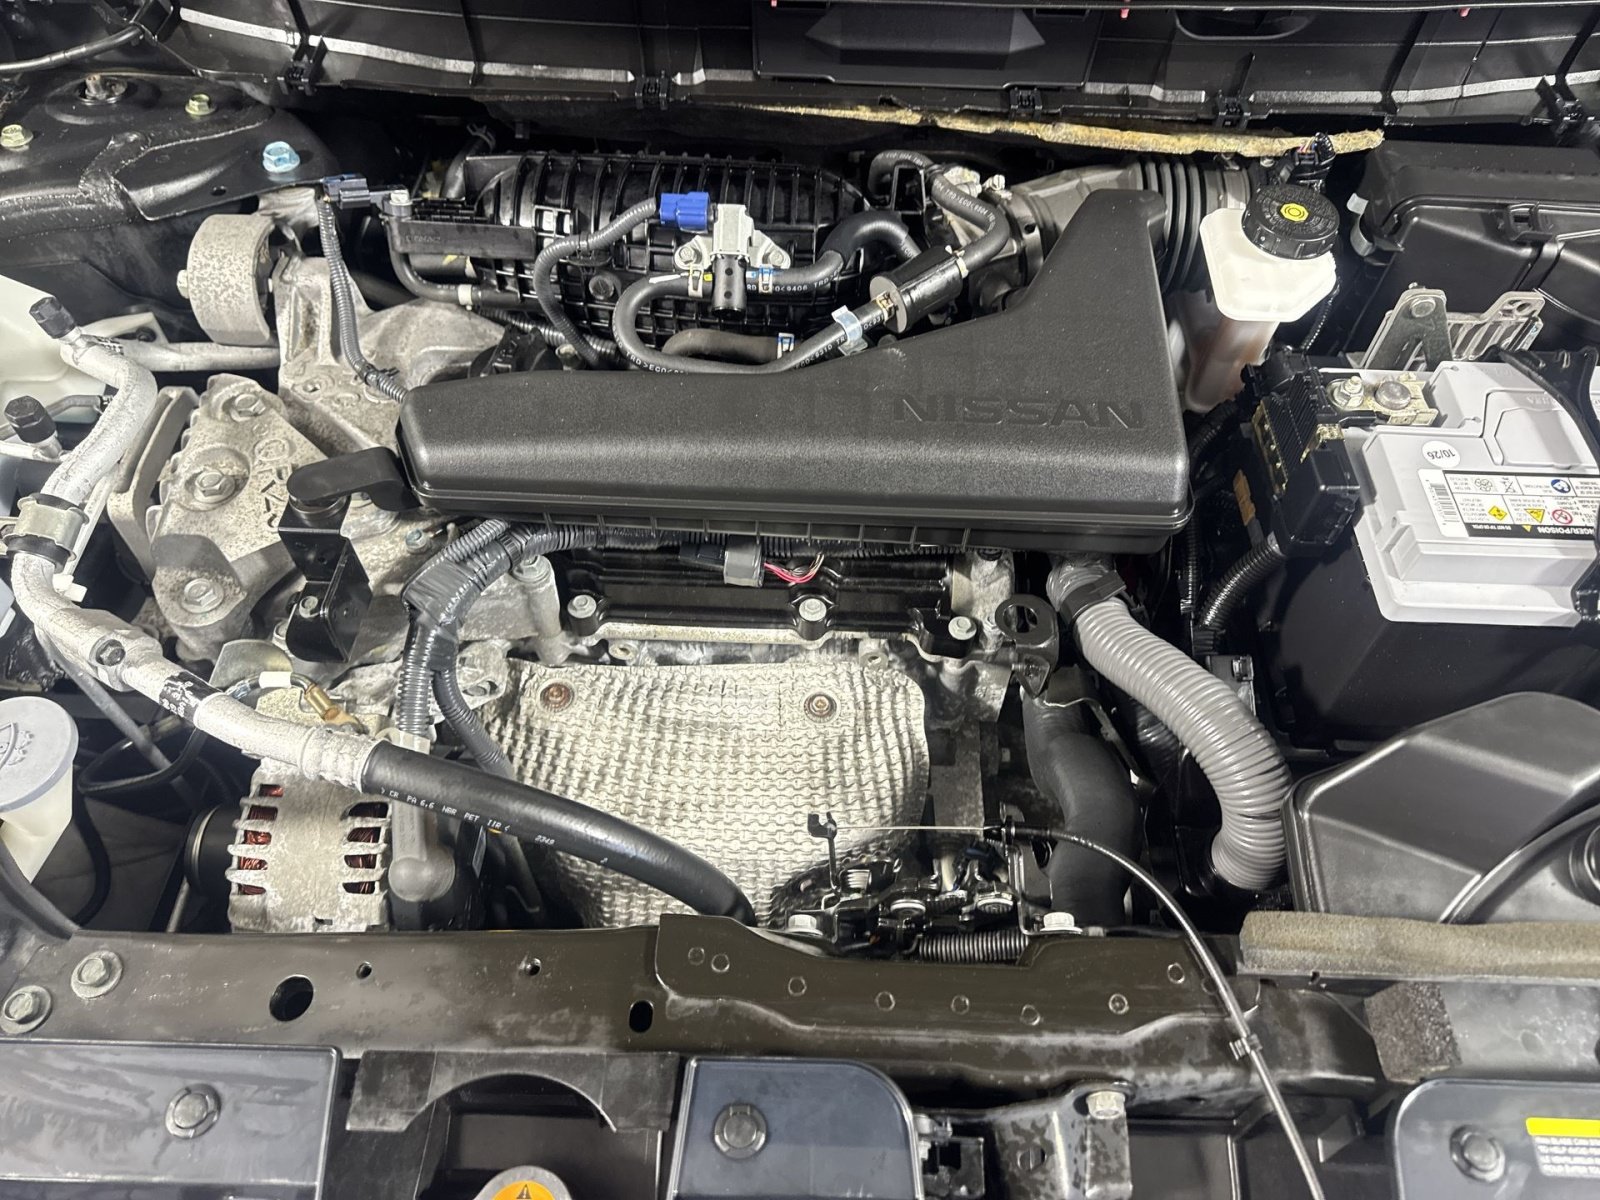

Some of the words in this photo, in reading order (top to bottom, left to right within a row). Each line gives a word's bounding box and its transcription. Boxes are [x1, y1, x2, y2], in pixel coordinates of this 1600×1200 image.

[893, 394, 1145, 430] NISSAN
[1427, 448, 1456, 460] 10/26
[406, 795, 418, 805] PA
[463, 811, 481, 823] PET
